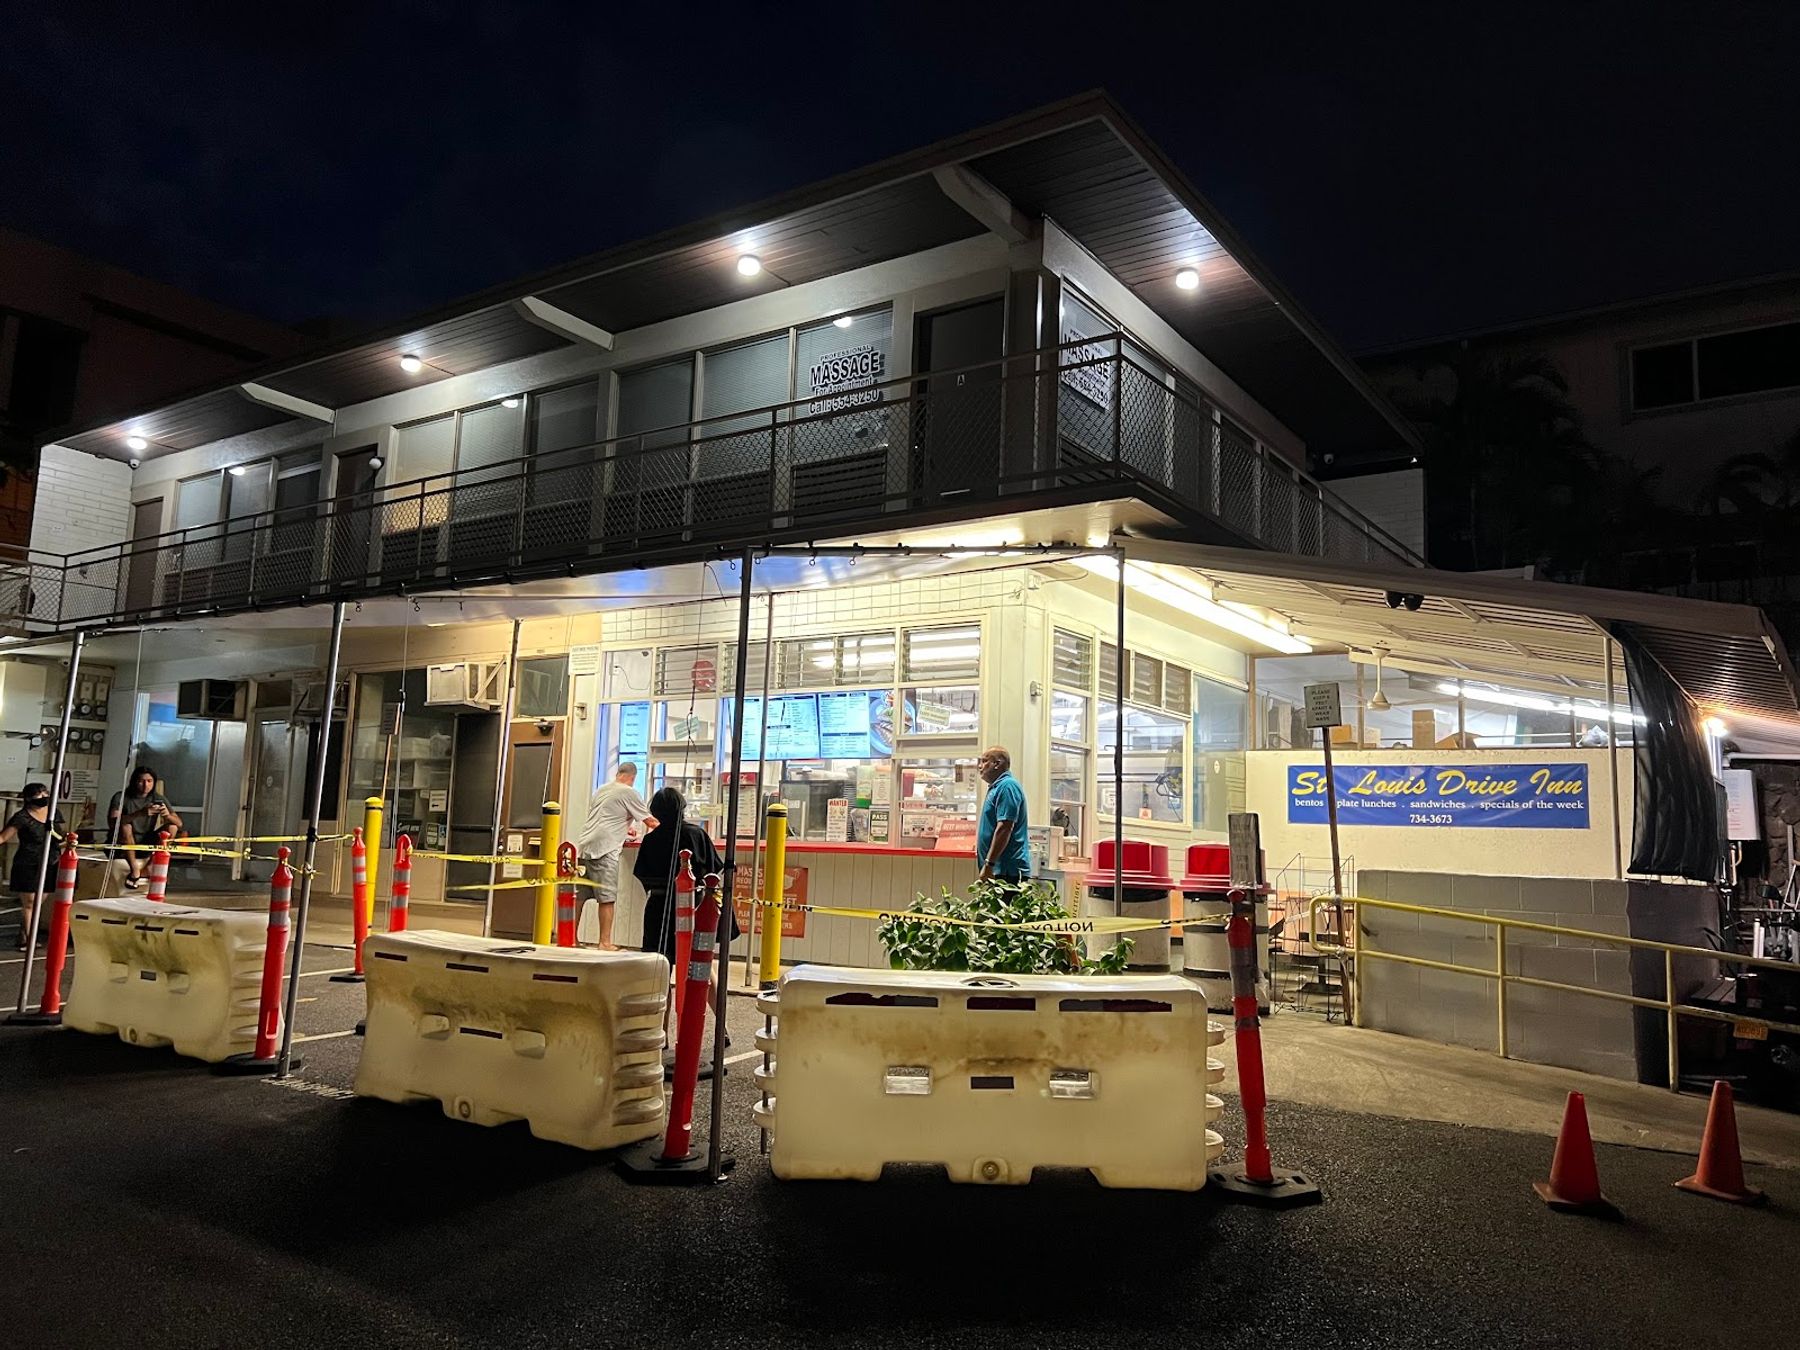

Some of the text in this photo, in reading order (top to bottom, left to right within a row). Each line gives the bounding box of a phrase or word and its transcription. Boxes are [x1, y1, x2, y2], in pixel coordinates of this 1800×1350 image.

[820, 345, 870, 361] PROFESSIONAL
[809, 352, 880, 386] MASSAGE
[809, 400, 831, 414] Call:
[1347, 770, 1427, 795] Louis
[1436, 769, 1517, 796] Drive
[1529, 768, 1583, 795] Inn
[1294, 798, 1585, 810] bentos plate lunches sandwiches specials of the week
[1409, 814, 1453, 824] 734-3673
[736, 866, 763, 879] MASS
